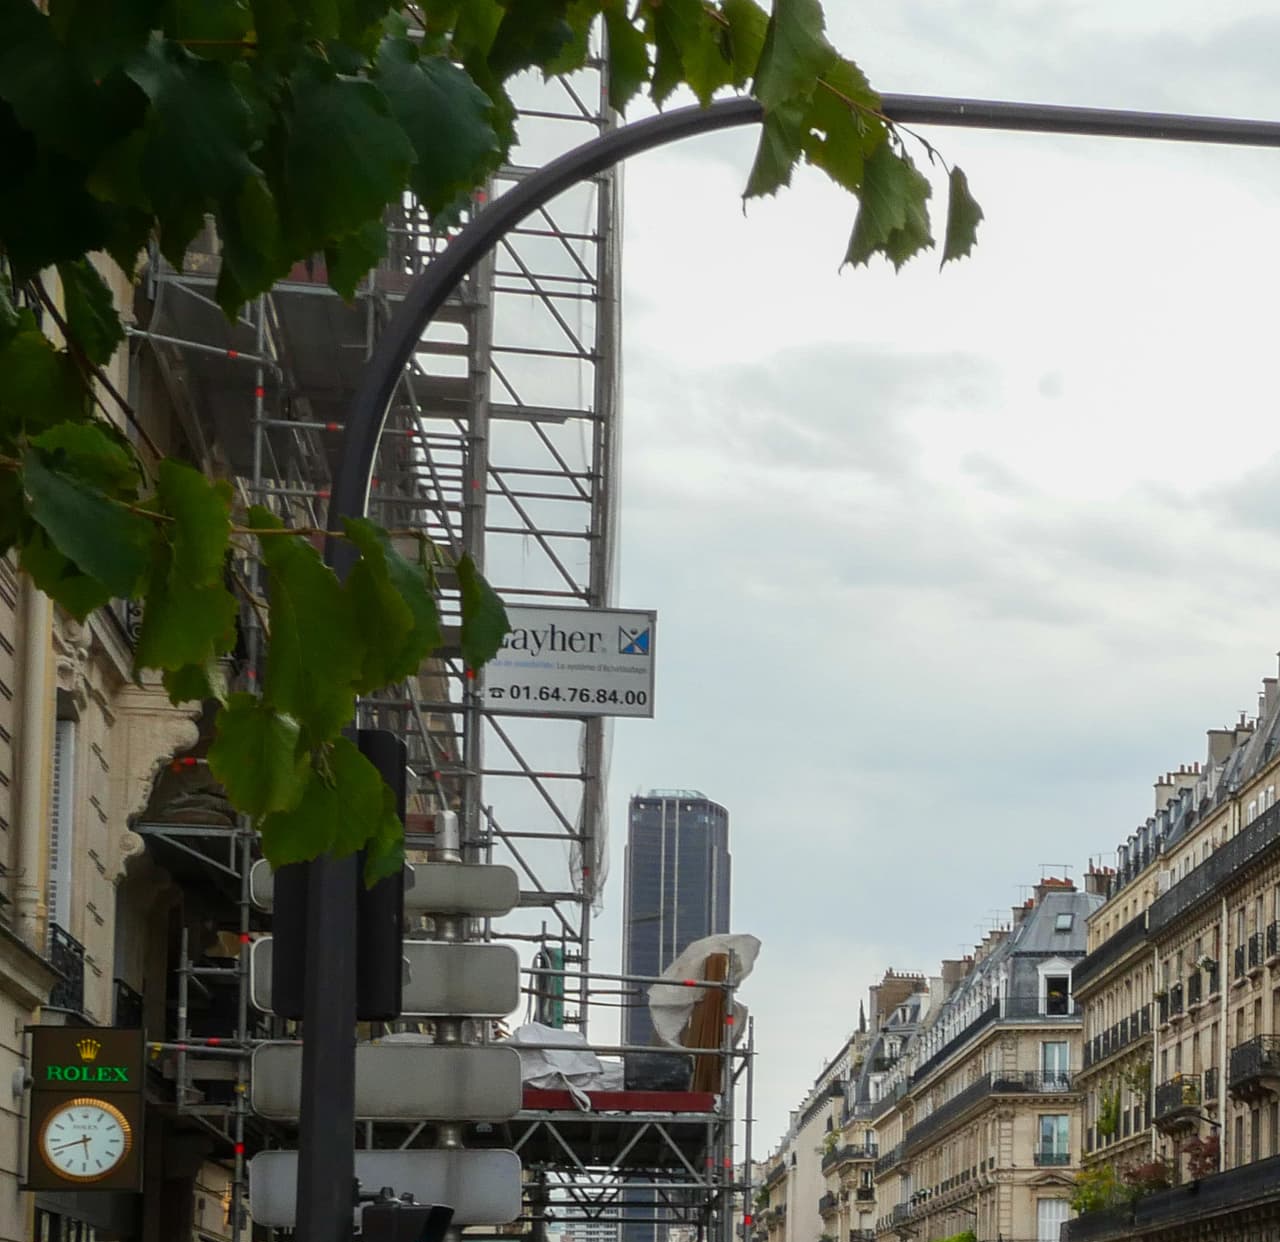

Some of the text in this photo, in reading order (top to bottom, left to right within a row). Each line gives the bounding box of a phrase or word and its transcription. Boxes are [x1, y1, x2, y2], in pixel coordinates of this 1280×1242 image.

[503, 624, 602, 657] ayher
[510, 685, 647, 705] 01.64.76.84.00
[47, 1065, 129, 1082] ROLEX
